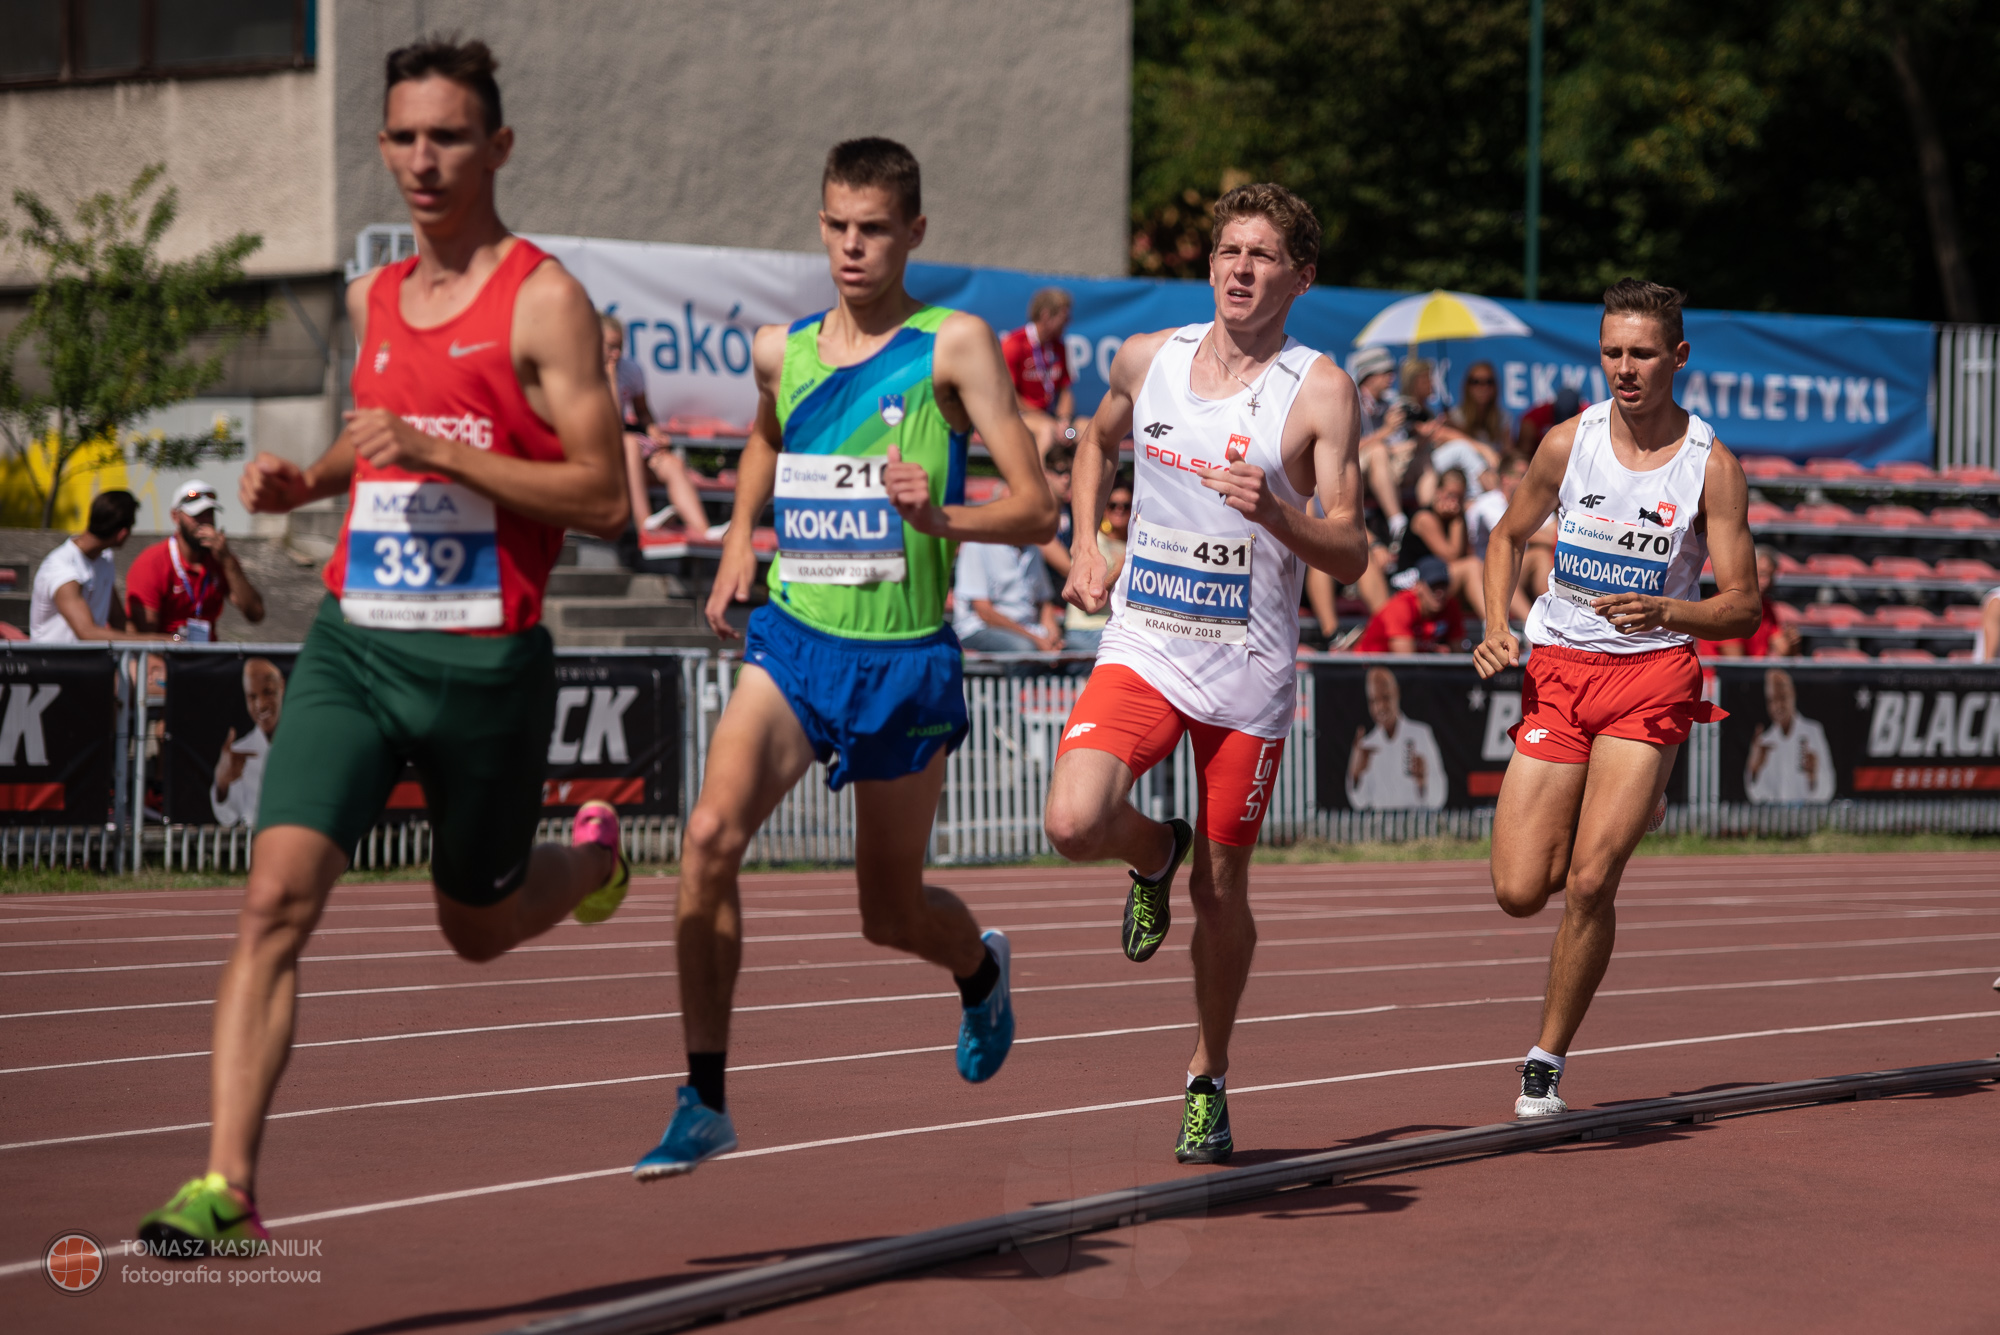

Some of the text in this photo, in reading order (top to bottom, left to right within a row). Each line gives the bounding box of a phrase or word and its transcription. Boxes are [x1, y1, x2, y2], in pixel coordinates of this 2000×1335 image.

[605, 302, 758, 377] rakó
[1682, 370, 1889, 424] ATLETYKI
[1143, 422, 1174, 439] 4F
[1146, 444, 1229, 474] POLS
[794, 470, 828, 482] Kraków
[1579, 494, 1606, 509] 4F
[785, 509, 888, 539] KOKALJ
[1151, 537, 1246, 567] Kraków 431
[1578, 526, 1670, 556] Kraków 470
[373, 536, 465, 586] 339
[799, 565, 877, 578] KRAKÓW 2018
[1558, 551, 1662, 591] WŁODARCZYK
[1131, 566, 1244, 608] KOWALCZYK
[1145, 618, 1222, 638] KRAKÓW 2018
[548, 686, 640, 765] CK
[1524, 728, 1550, 744] 4F
